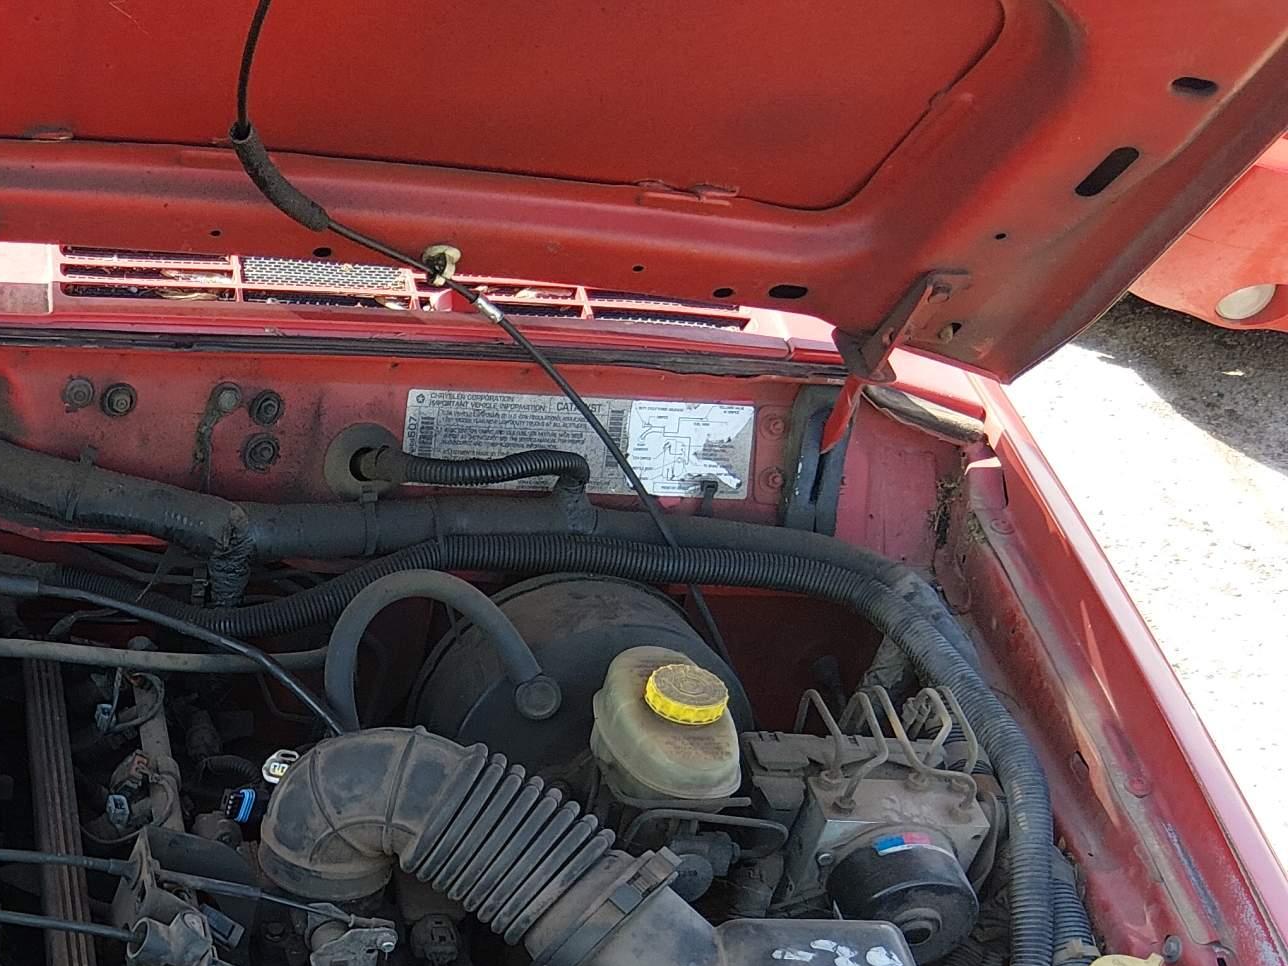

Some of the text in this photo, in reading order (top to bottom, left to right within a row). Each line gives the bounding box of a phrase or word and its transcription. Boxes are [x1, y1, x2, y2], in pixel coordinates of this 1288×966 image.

[430, 392, 515, 402] CHRYSLER CORPORATION
[429, 399, 546, 412] IMPORTANT VEHICLE INFORMATION
